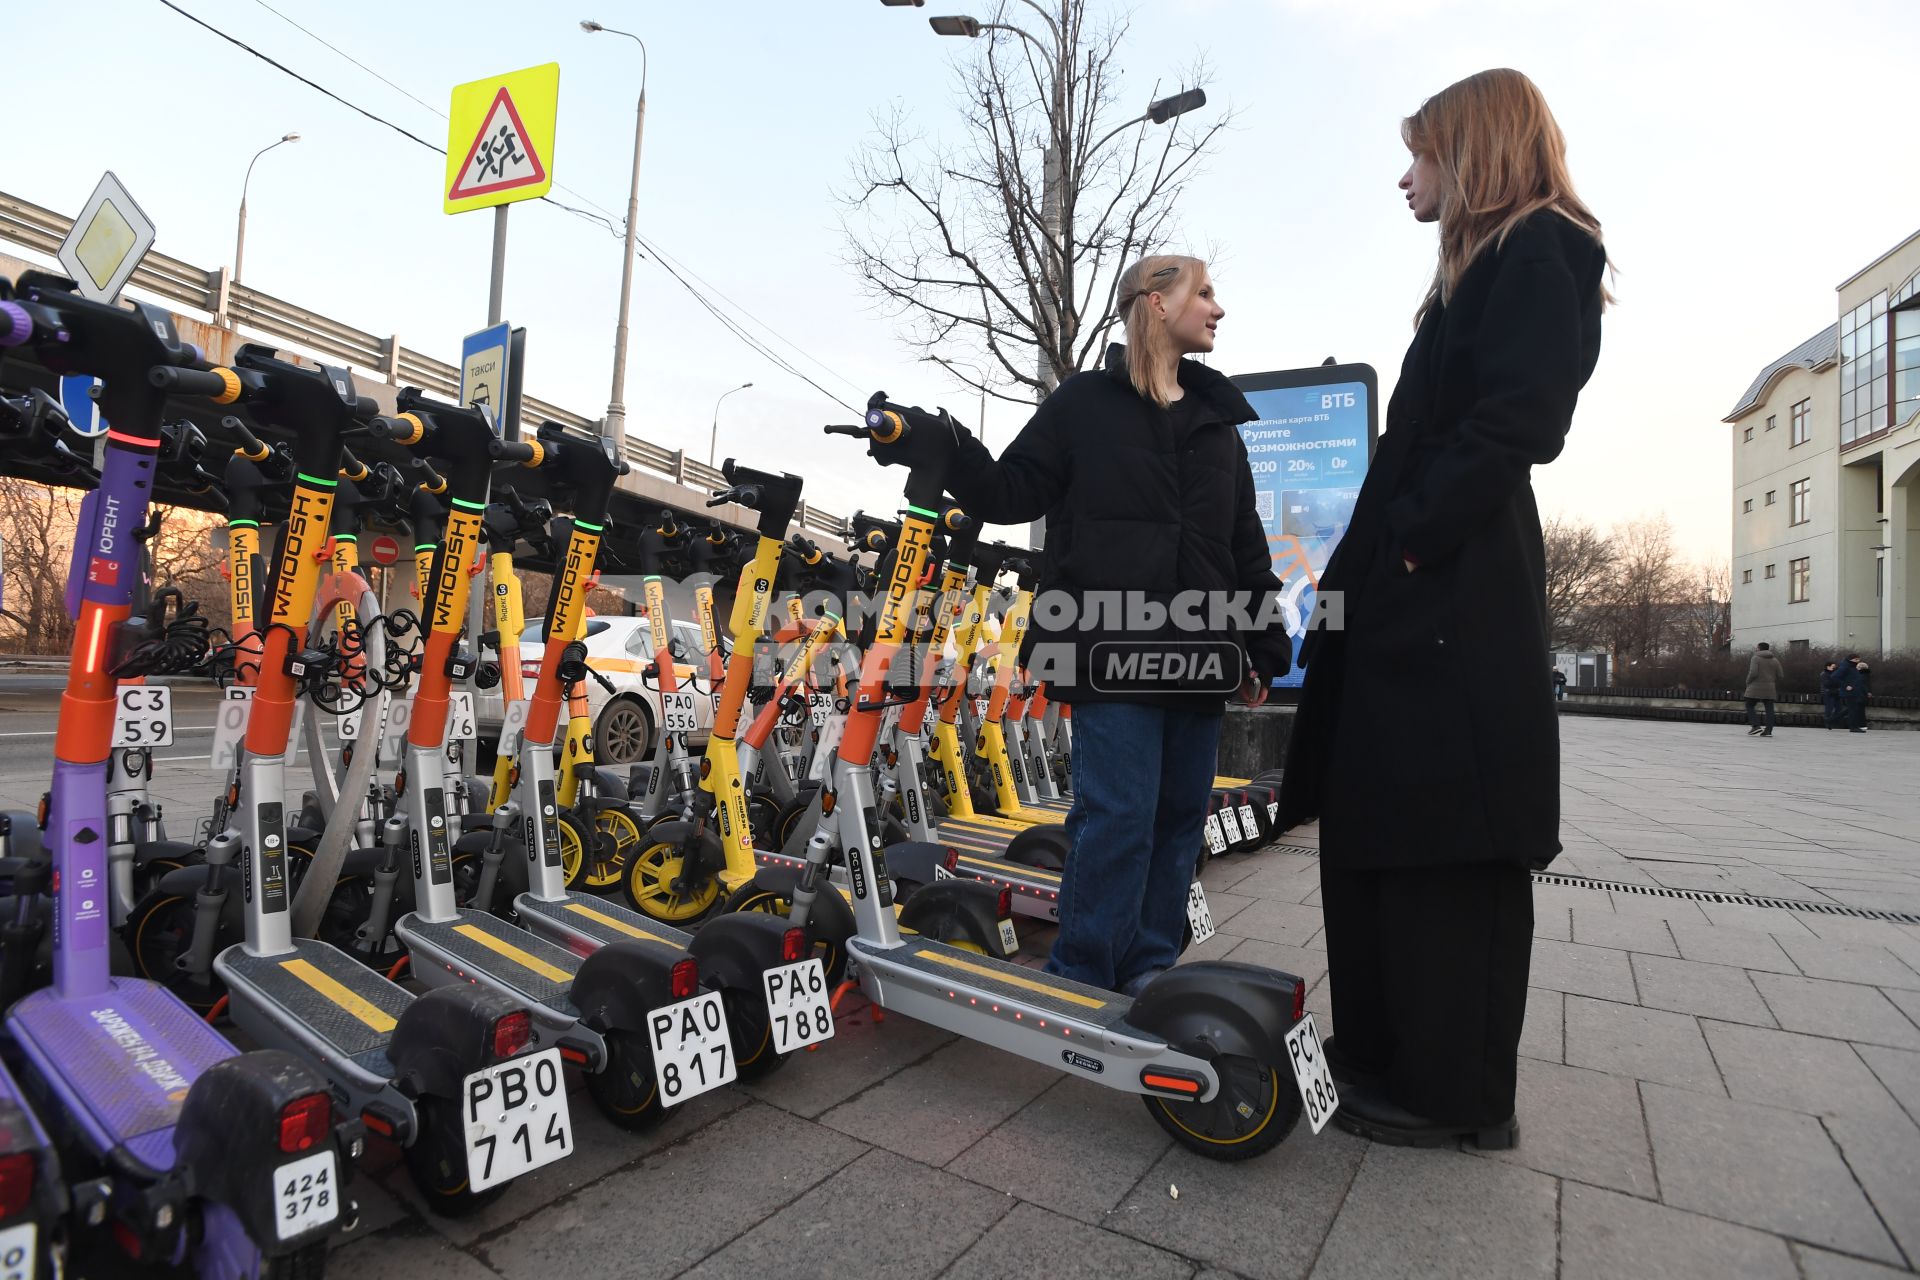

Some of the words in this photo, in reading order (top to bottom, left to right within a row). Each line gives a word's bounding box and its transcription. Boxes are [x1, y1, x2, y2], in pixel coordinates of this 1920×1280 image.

[470, 361, 496, 378] такси
[1289, 416, 1313, 425] карта
[1314, 413, 1330, 422] ВТБ
[1321, 392, 1356, 409] ВТБ
[1243, 429, 1291, 442] Рулите
[1287, 460, 1316, 472] 20%
[99, 495, 121, 554] ЮРЕНТ
[235, 533, 251, 620] WHOOSH
[273, 495, 311, 617] WHOOSH
[434, 519, 467, 626] WHOOSH
[497, 584, 508, 596] Go
[552, 538, 585, 634] WHOOSH
[748, 594, 763, 626] Яндекс
[756, 579, 768, 593] Go
[879, 526, 923, 640] WHOOSH
[648, 586, 665, 648] WHOOSH
[699, 591, 716, 650] WHOOSH
[930, 577, 963, 652] WHOOSH
[787, 620, 826, 678] WHOOSH
[1557, 656, 1577, 665] WC
[124, 720, 167, 742] 59
[667, 715, 695, 728] 556
[1002, 927, 1013, 937] 146
[1192, 912, 1213, 940] 560
[776, 1004, 830, 1048] 788
[662, 1043, 728, 1099] 817
[1305, 1068, 1336, 1124] 886
[473, 1112, 566, 1181] 714
[283, 1167, 330, 1199] 424
[286, 1189, 331, 1221] 378
